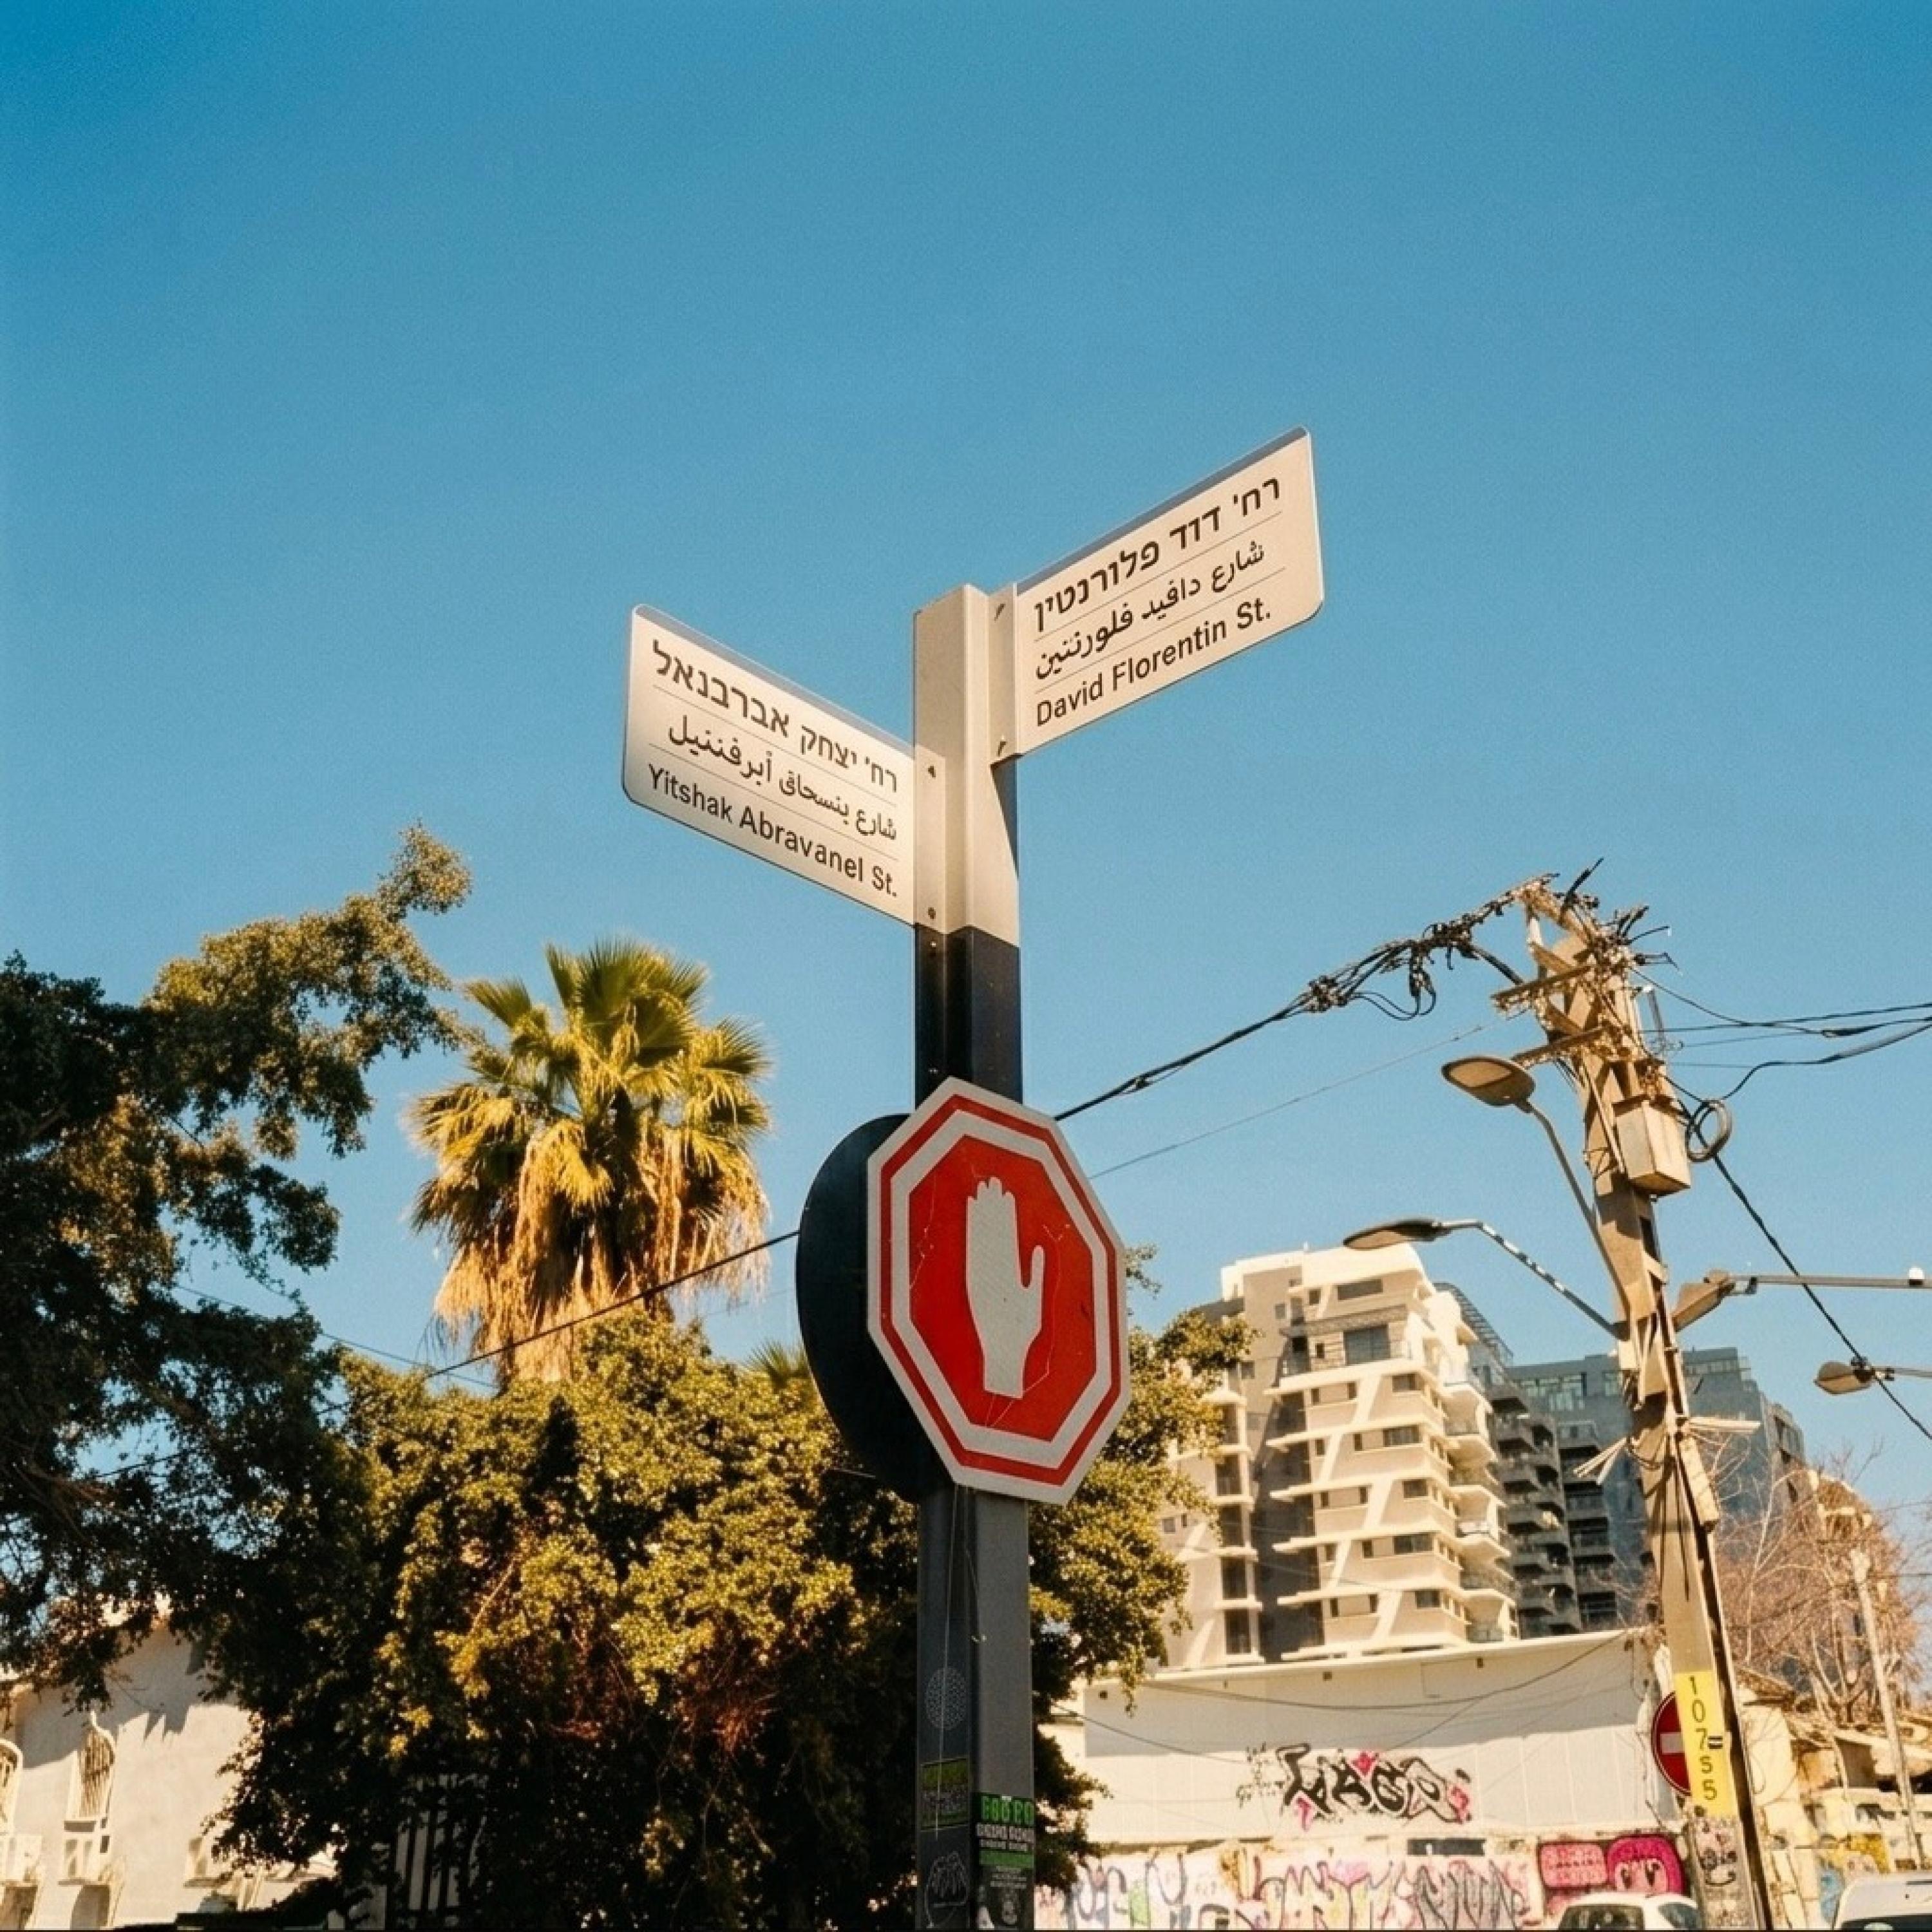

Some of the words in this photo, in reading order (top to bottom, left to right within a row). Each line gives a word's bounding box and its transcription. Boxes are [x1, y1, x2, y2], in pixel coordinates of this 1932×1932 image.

[1169, 505, 1222, 551] דוד
[1033, 540, 1161, 633] פלורנטין
[1211, 539, 1265, 593] شارع
[1141, 576, 1202, 621] دافيد
[652, 639, 790, 739] אברבנאל
[1037, 671, 1104, 727] David
[1112, 620, 1227, 693] Florentin
[1235, 597, 1271, 631] St.
[799, 724, 857, 770] יצחק
[647, 762, 733, 825] Yitshak
[739, 805, 864, 884] Abravanel
[871, 865, 897, 898] St.
[855, 809, 897, 840] شارع
